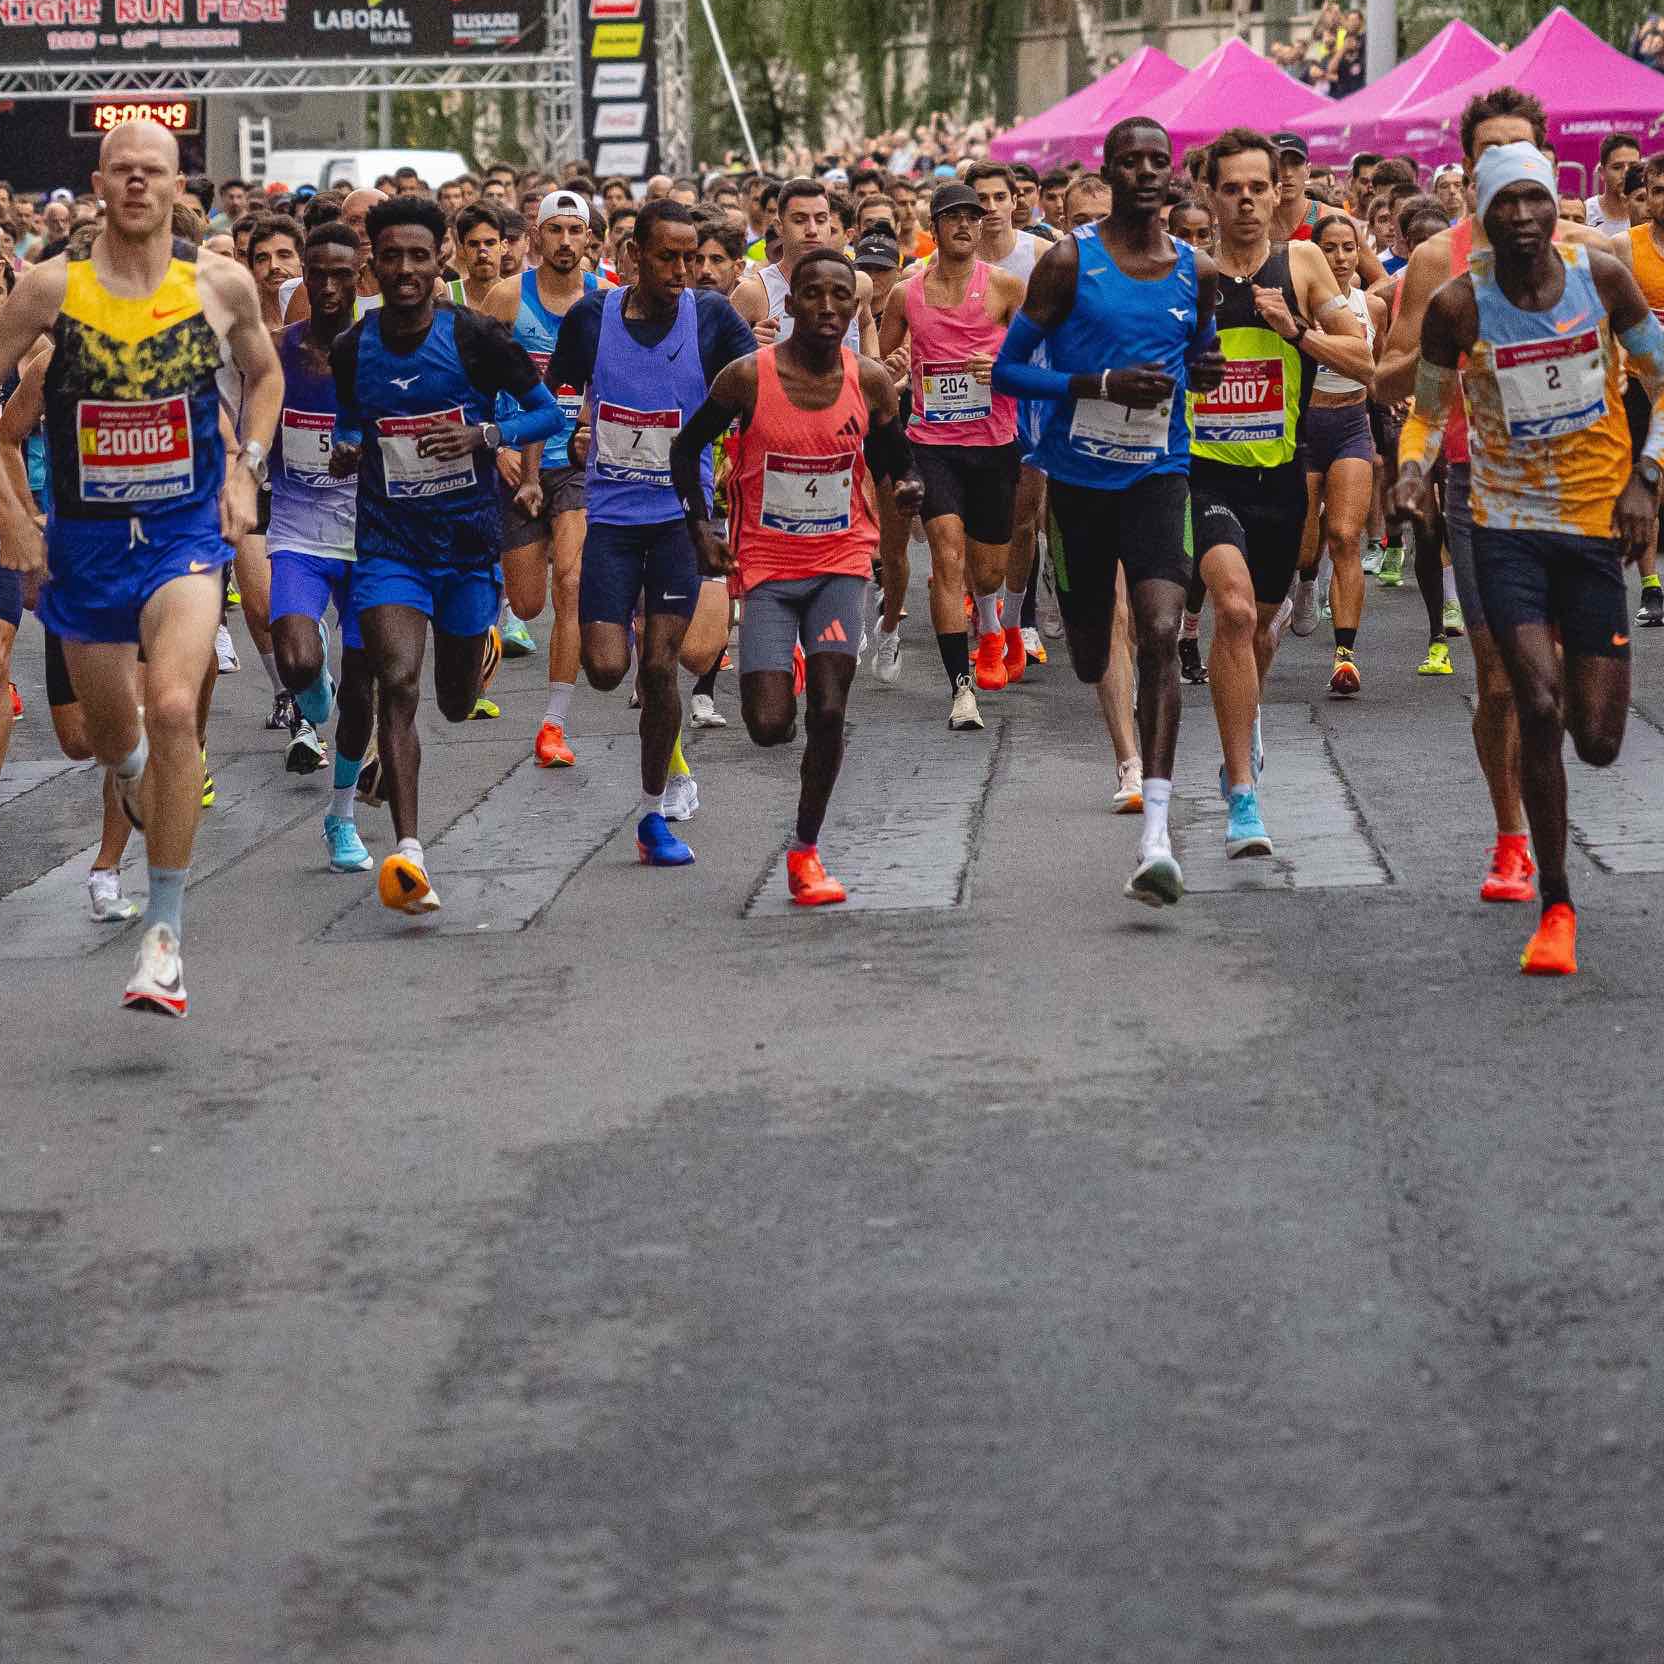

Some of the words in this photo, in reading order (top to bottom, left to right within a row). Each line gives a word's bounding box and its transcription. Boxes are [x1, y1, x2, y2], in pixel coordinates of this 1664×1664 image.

[313, 8, 411, 30] LABORAL
[94, 103, 187, 130] 19:00:49
[940, 377, 969, 394] 204
[1545, 365, 1562, 390] 2
[1206, 380, 1270, 405] 20007
[97, 424, 175, 456] 20002
[319, 433, 330, 453] 5
[632, 430, 643, 449] 7
[805, 478, 818, 498] 4
